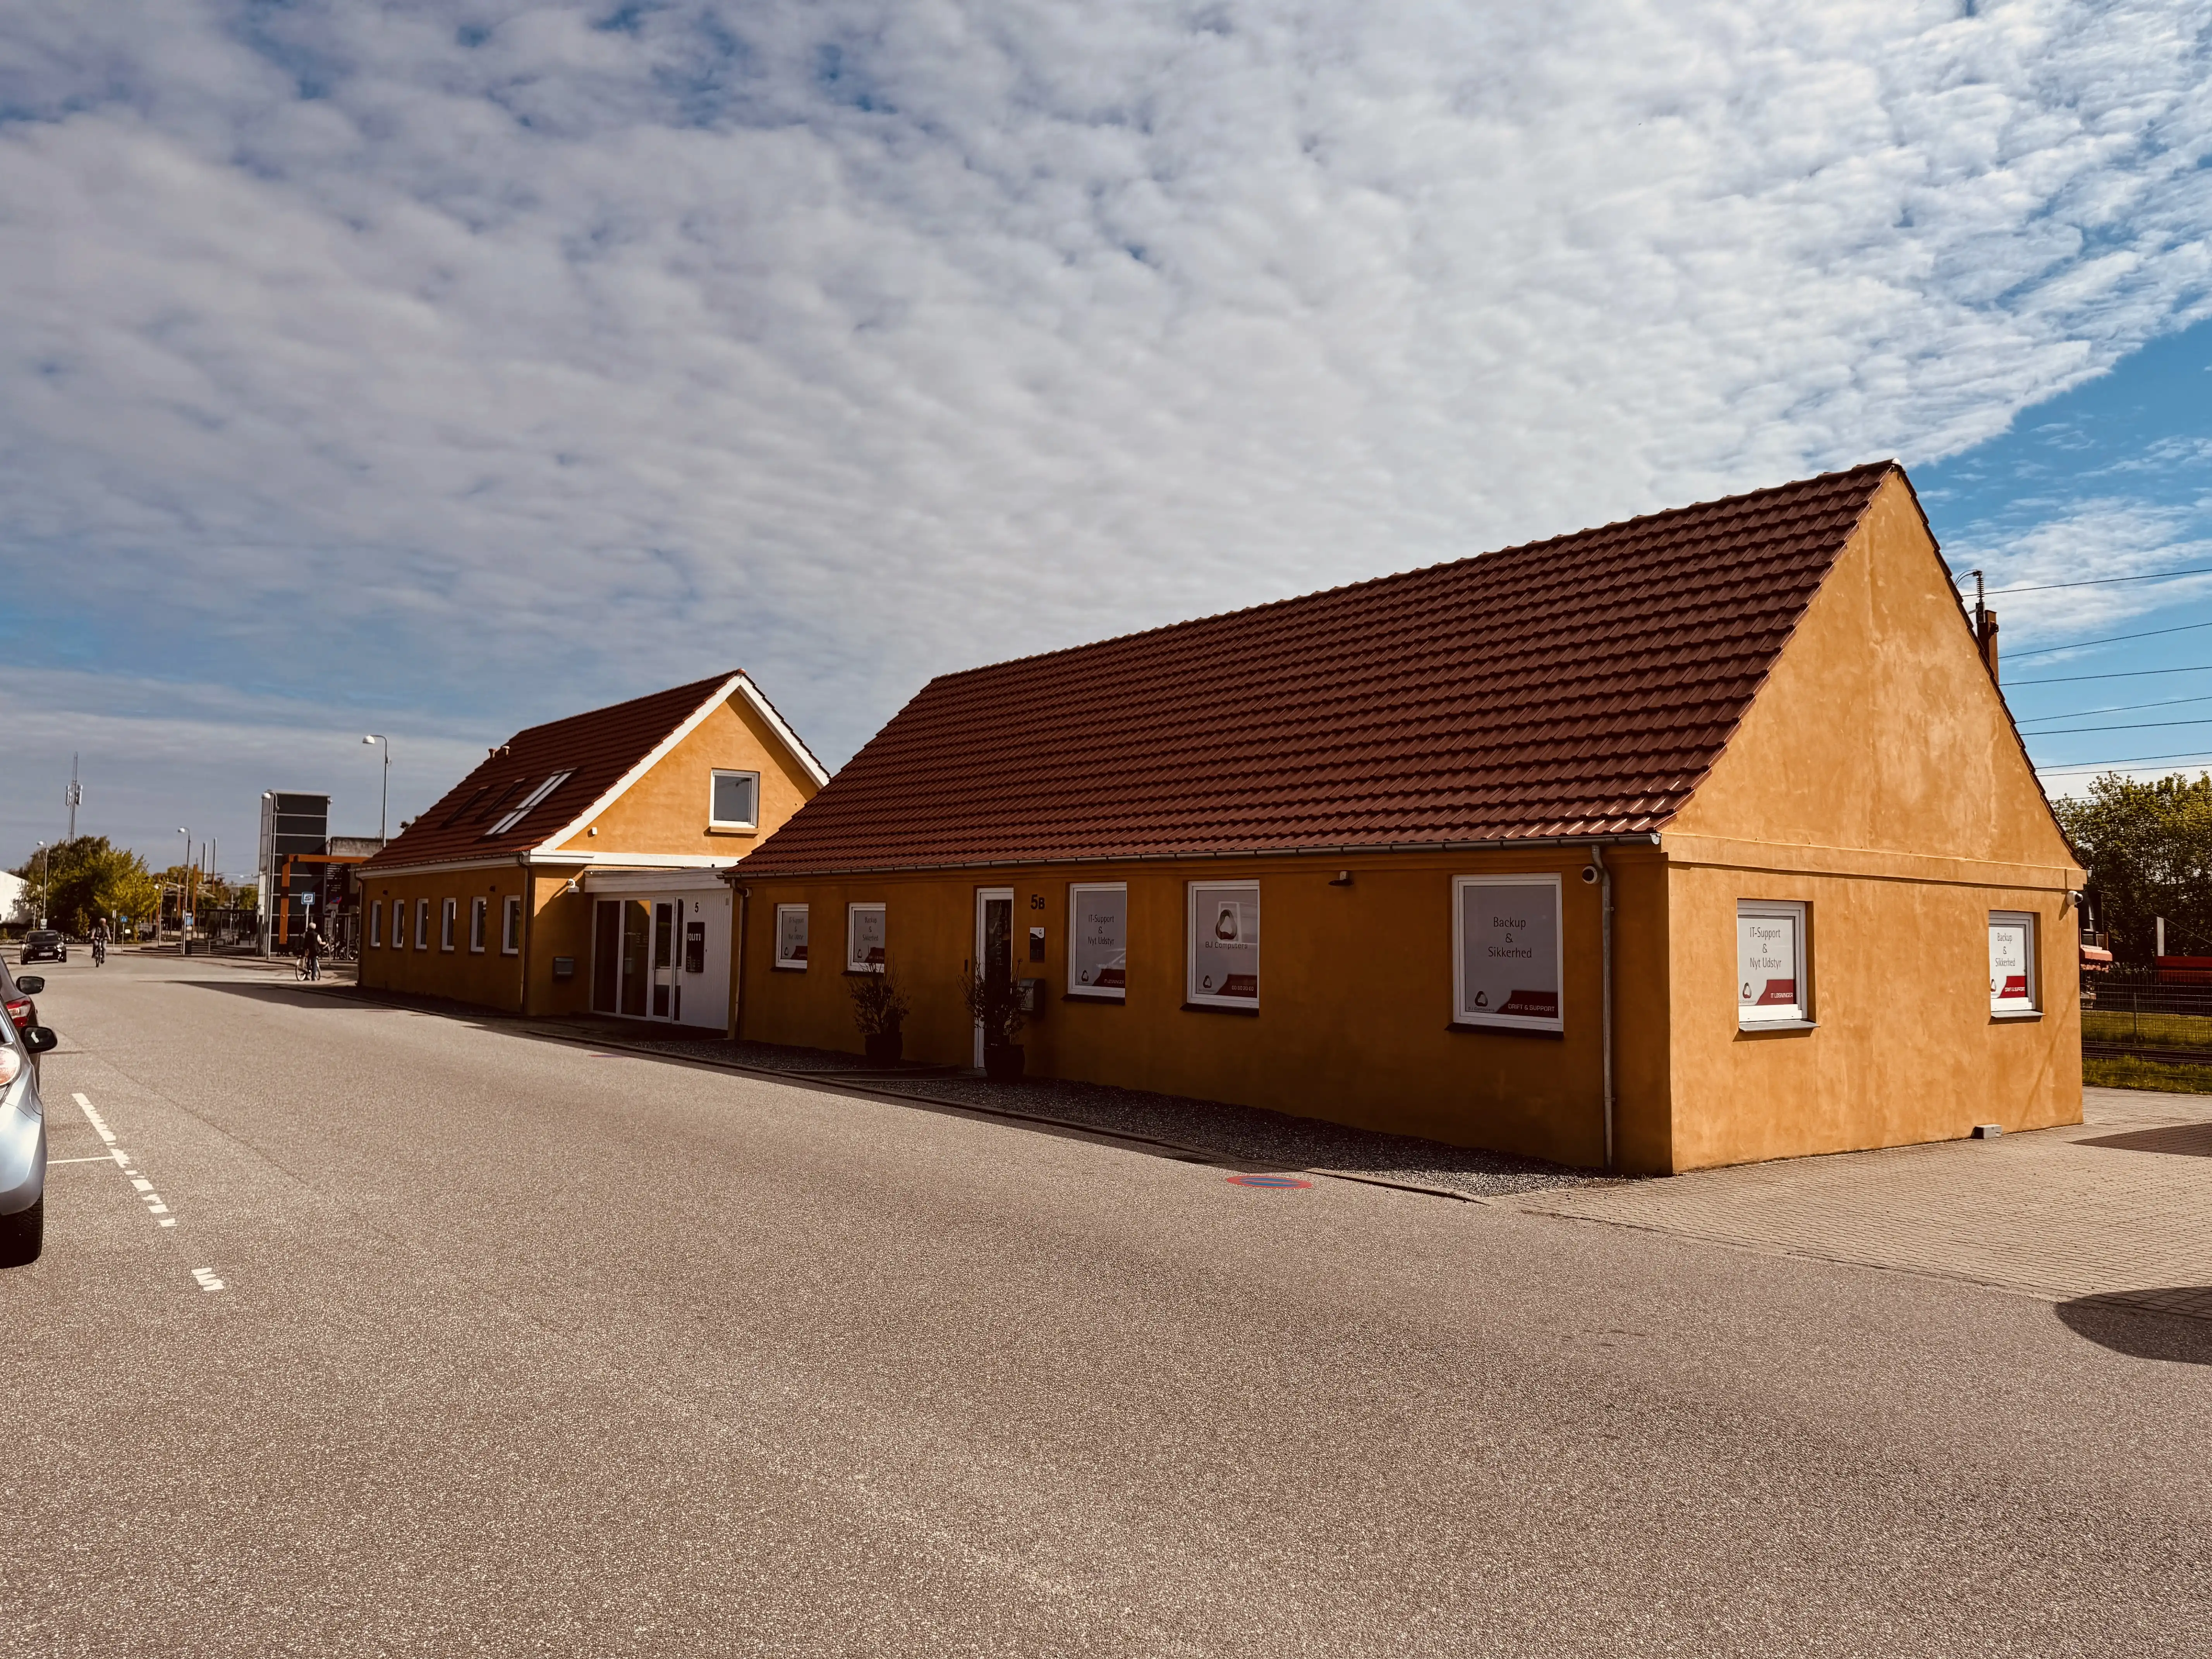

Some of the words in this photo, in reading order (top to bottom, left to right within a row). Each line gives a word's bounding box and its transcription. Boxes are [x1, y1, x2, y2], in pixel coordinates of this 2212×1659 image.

[1030, 894, 1045, 910] 5B
[695, 902, 699, 913] 5
[1089, 914, 1114, 924] IT-Support
[1494, 916, 1526, 930] Backup
[687, 933, 701, 941] POLITI
[1506, 933, 1513, 943] &
[1750, 927, 1781, 941] IT-Support
[1997, 933, 2012, 944] Backup
[1088, 936, 1096, 946] Nyt
[1098, 936, 1115, 946] Udstyr
[1215, 941, 1248, 950] Computers
[1488, 946, 1532, 958] Sikkerhed
[1762, 943, 1767, 953] &
[1750, 957, 1760, 970] Nyt
[1762, 957, 1781, 970] Udstyr
[1996, 958, 2016, 967] Sikkerhed
